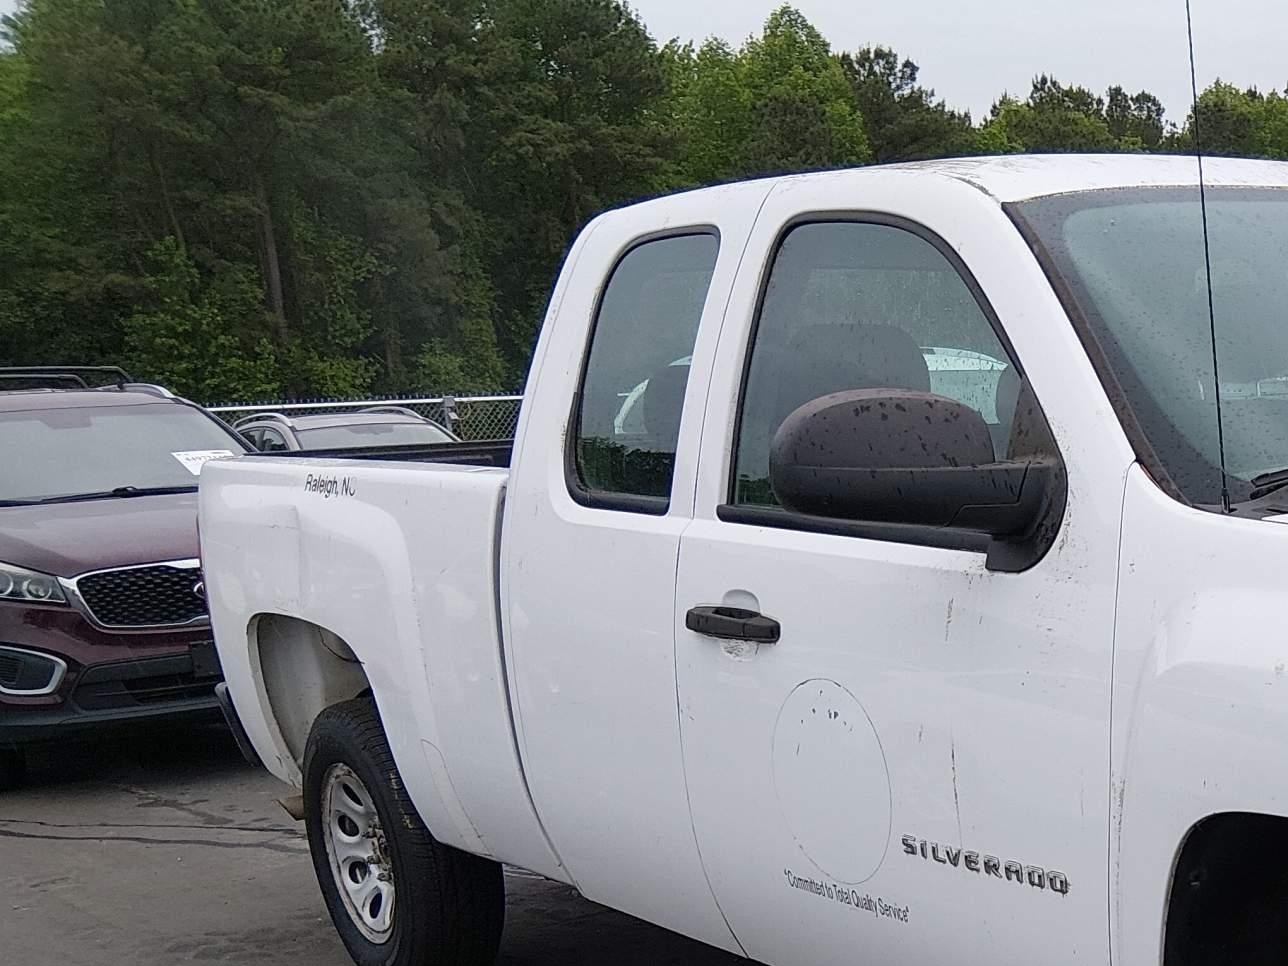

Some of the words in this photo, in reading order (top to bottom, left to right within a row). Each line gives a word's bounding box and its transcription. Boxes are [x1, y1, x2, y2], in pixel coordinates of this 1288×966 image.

[304, 474, 338, 498] Raleigh,
[901, 834, 1070, 895] SILVERADO
[825, 881, 834, 899] to
[832, 883, 852, 905] Total
[851, 889, 878, 918] Quality
